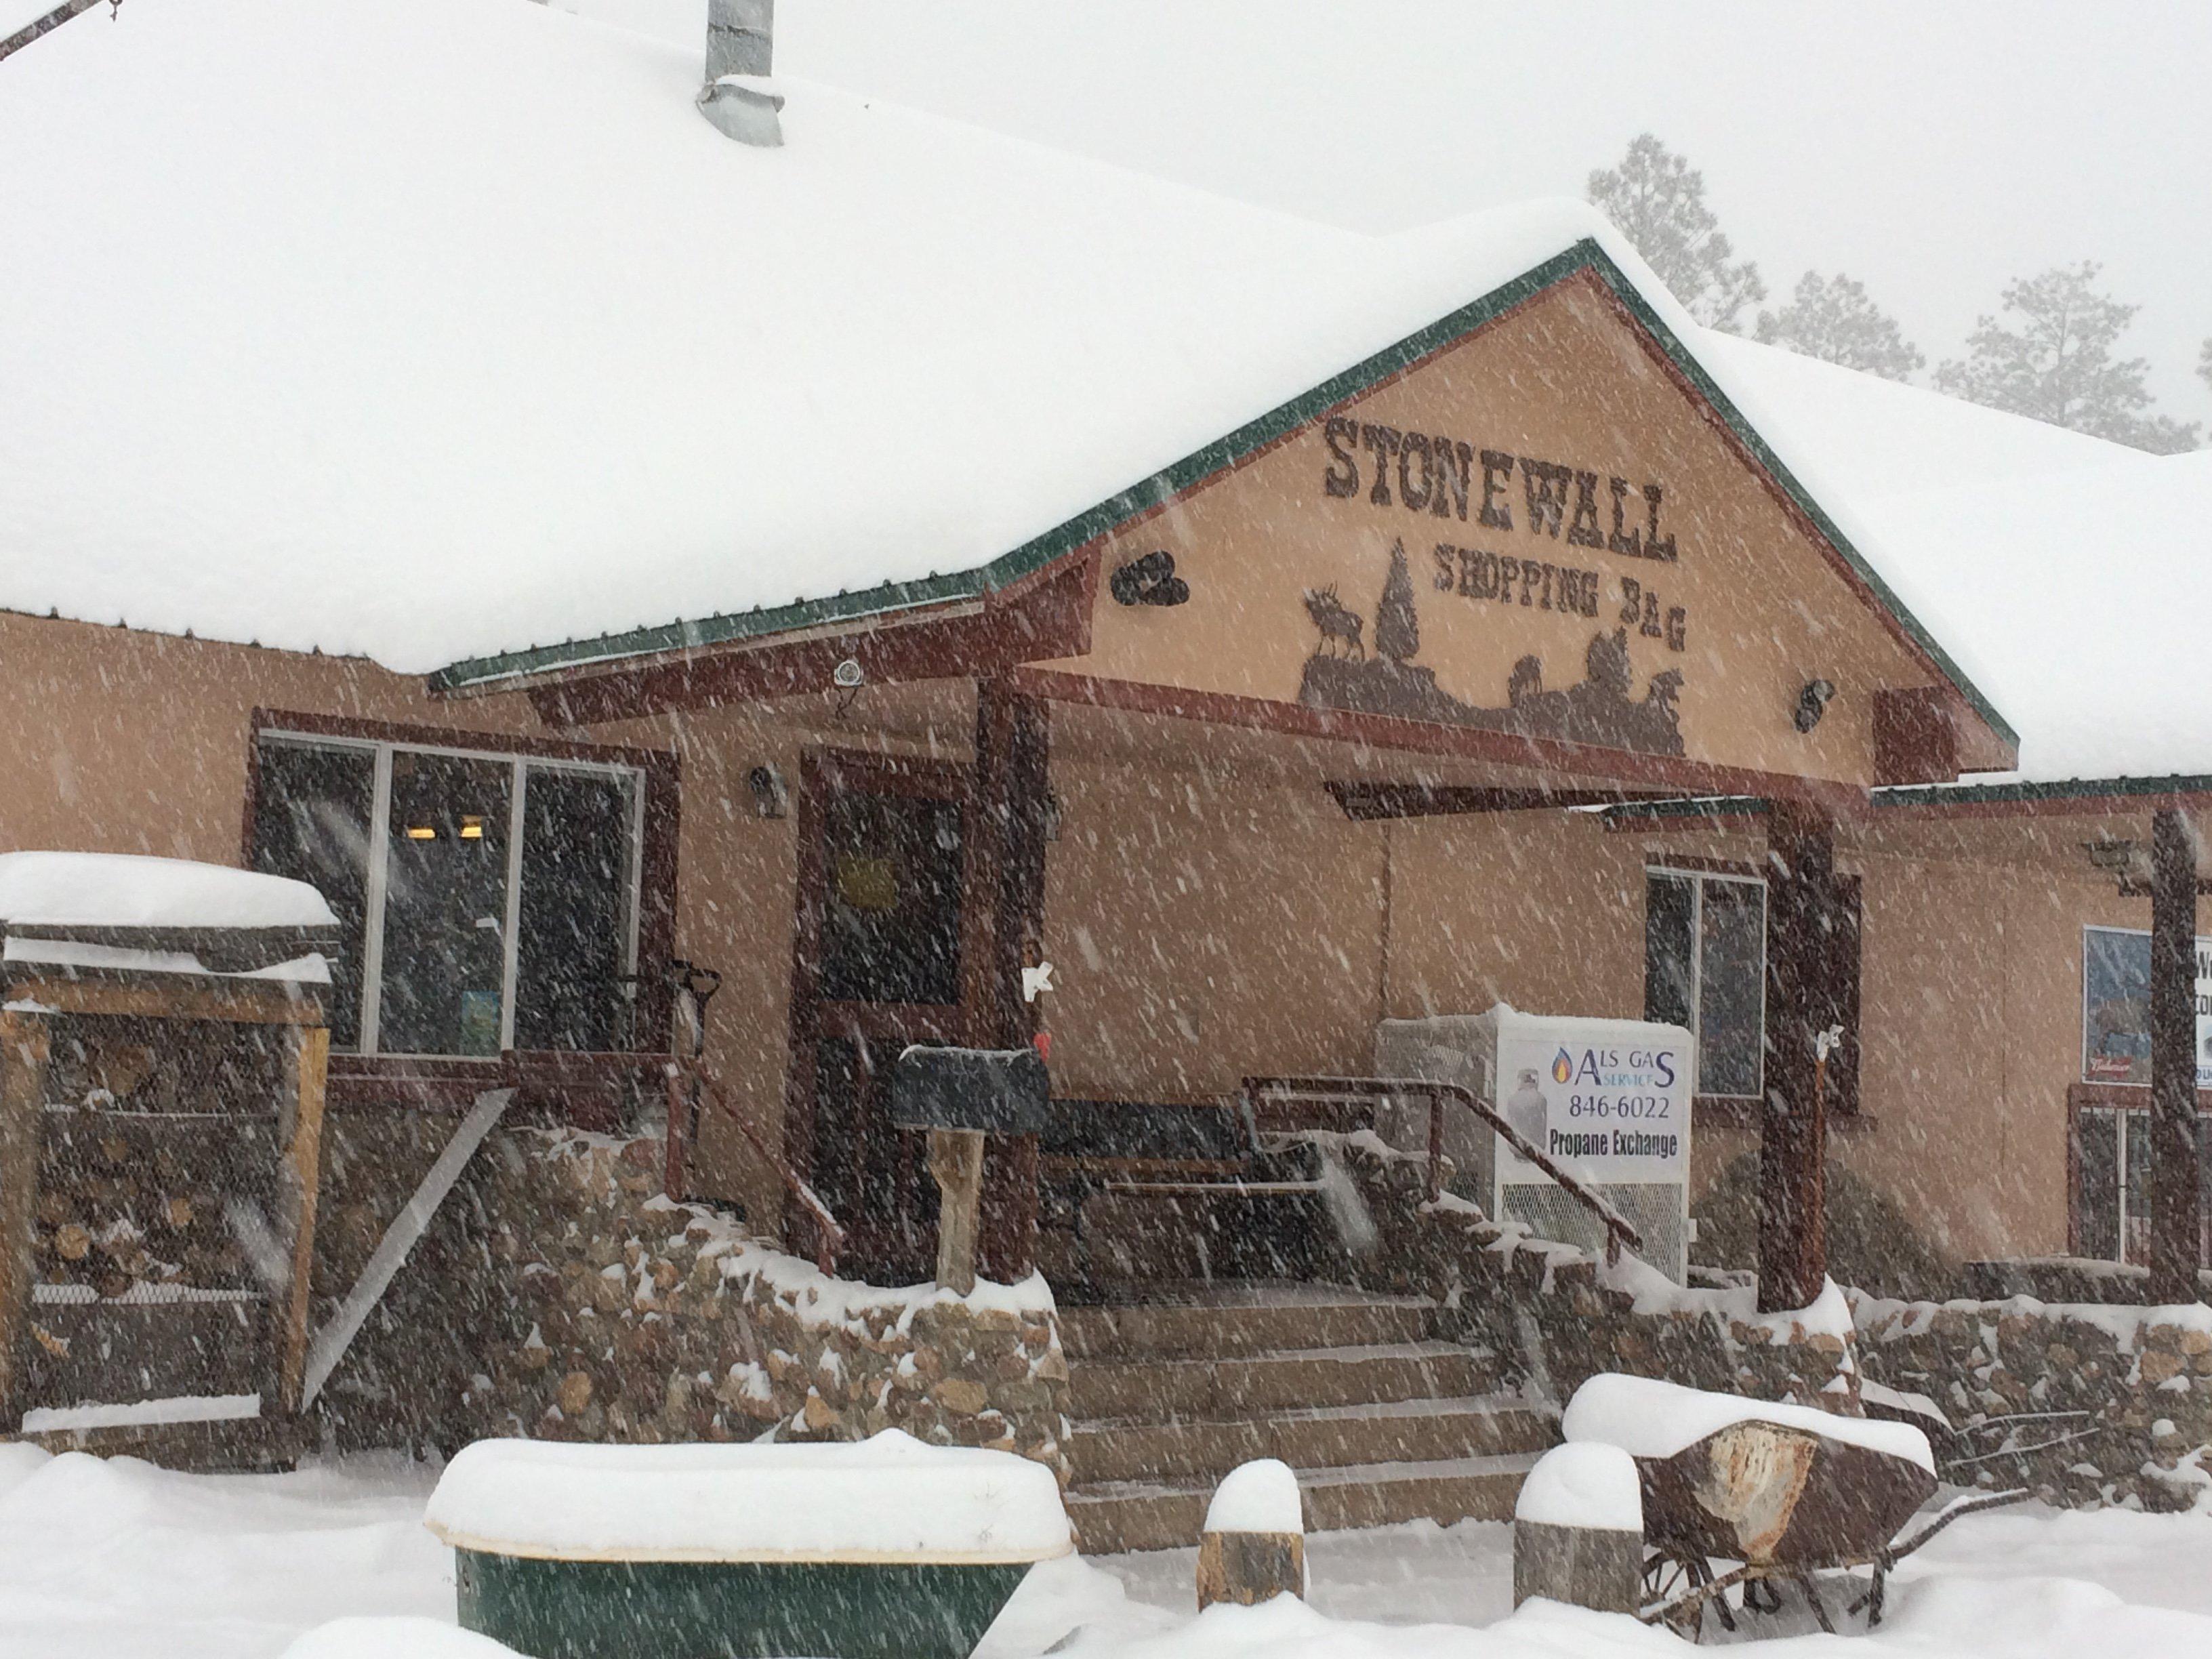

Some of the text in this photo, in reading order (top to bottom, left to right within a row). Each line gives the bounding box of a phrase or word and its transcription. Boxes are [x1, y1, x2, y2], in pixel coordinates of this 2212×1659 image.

[1324, 415, 1678, 562] STONEWALL
[1433, 543, 1686, 652] SHOPPING BAG
[1574, 1048, 1675, 1088] ALS GAS
[1570, 1094, 1670, 1119] 846-6022
[1549, 1128, 1678, 1159] Propane Exchange
